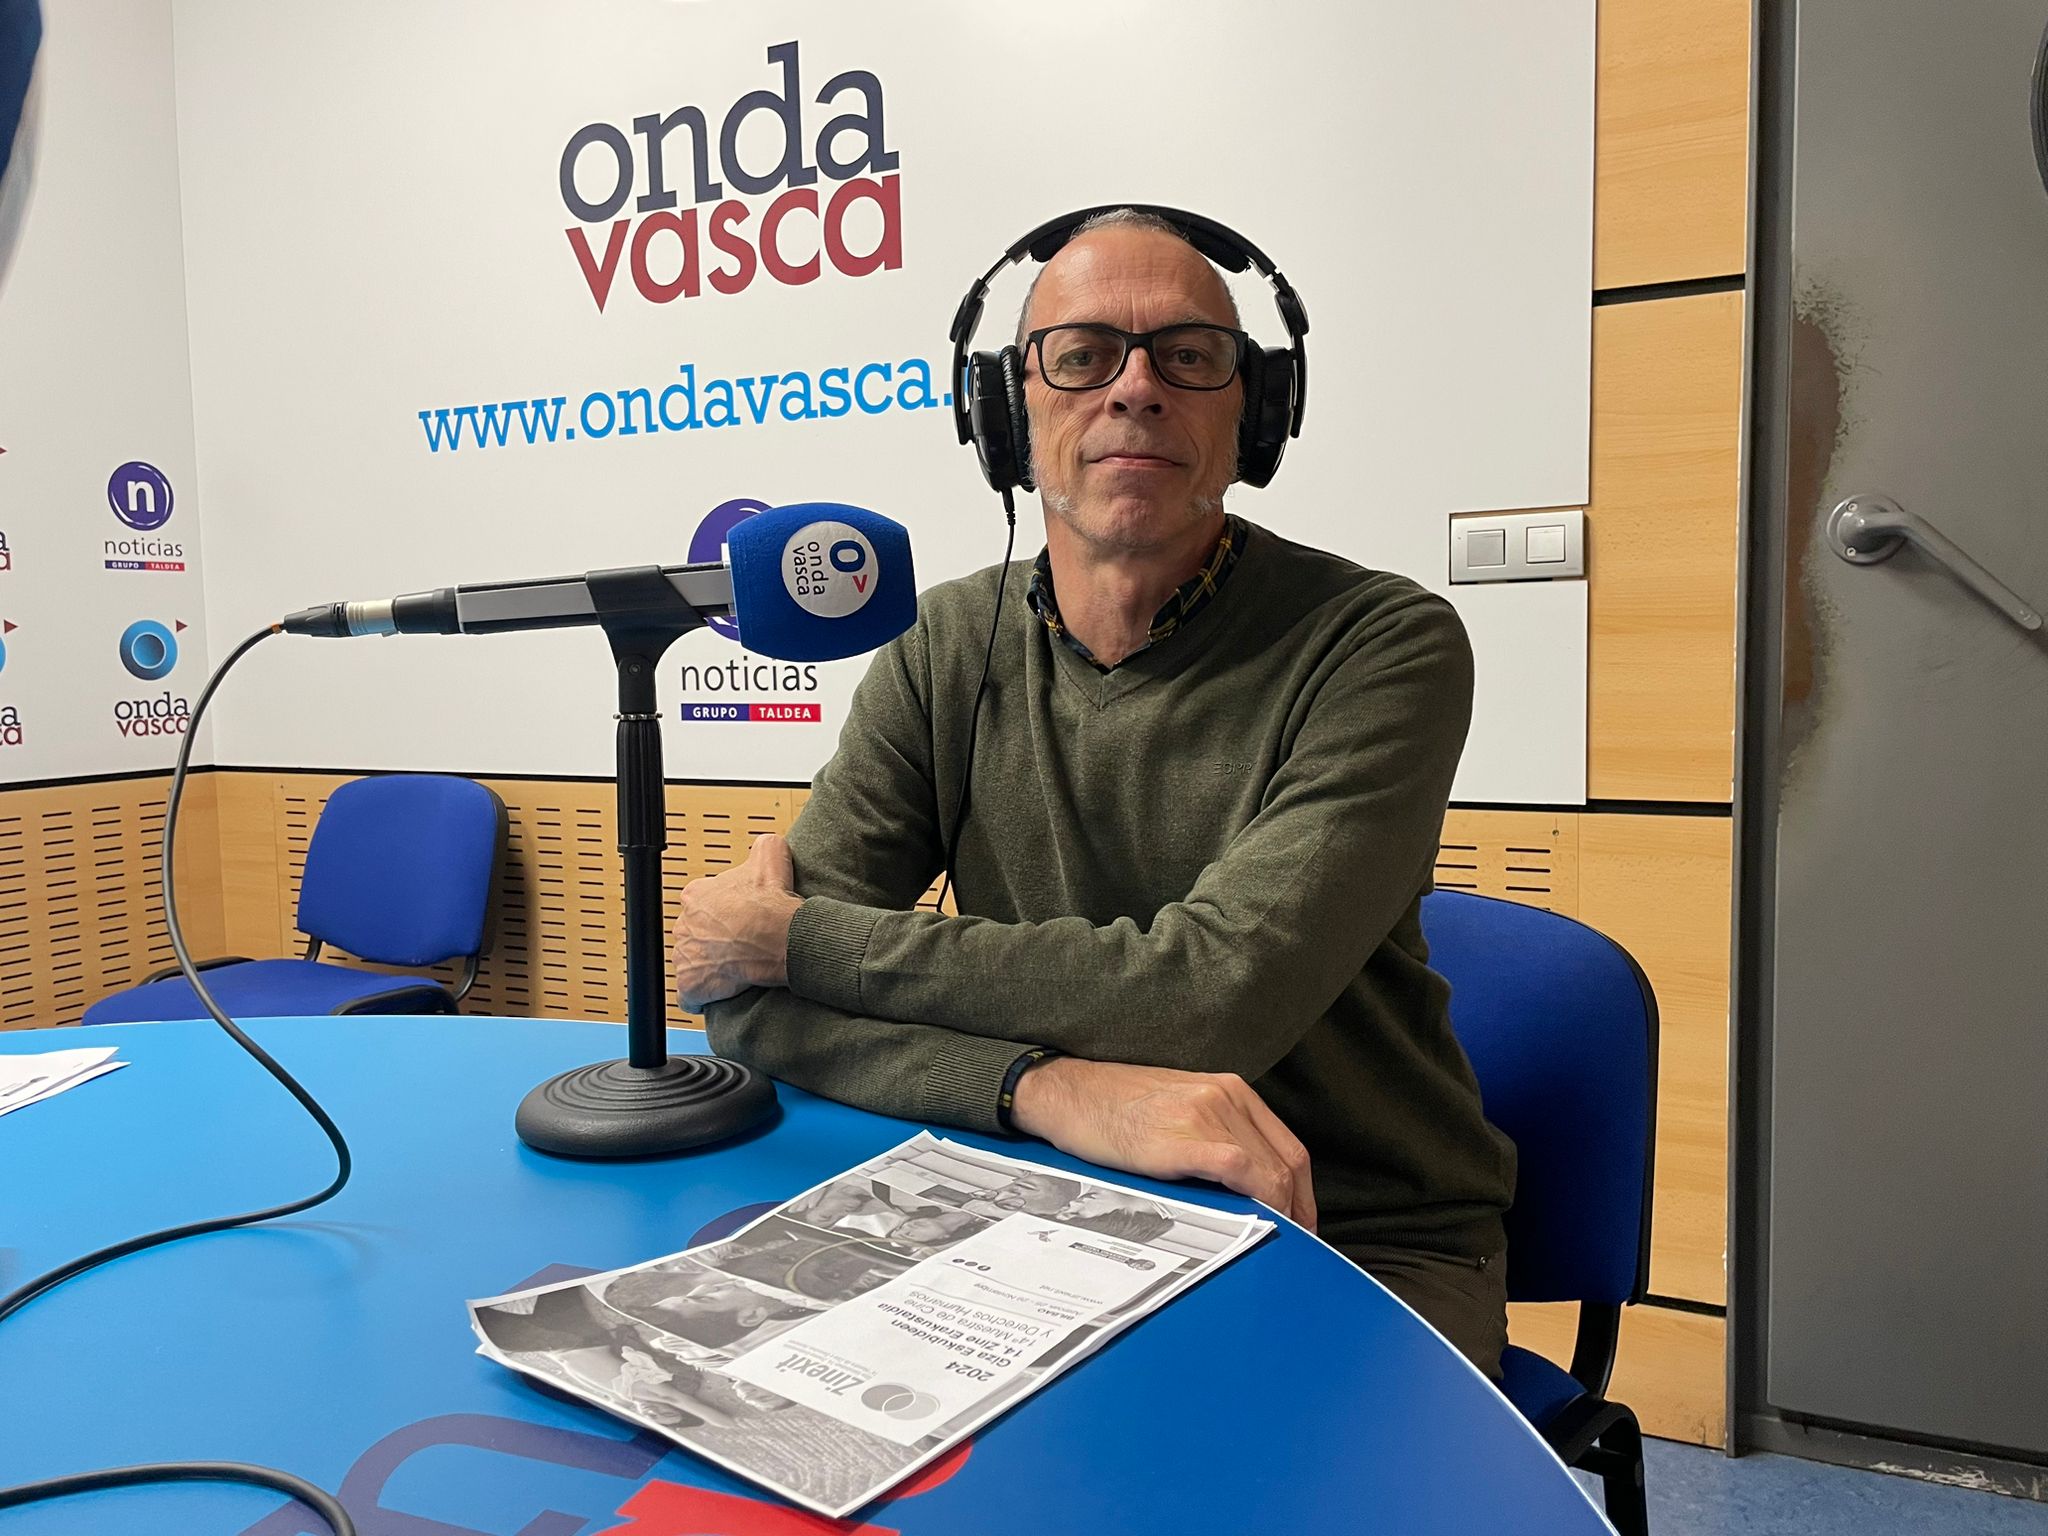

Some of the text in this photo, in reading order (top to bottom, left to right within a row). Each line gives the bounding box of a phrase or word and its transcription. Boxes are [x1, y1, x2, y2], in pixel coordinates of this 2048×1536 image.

[559, 40, 900, 223] onda
[565, 173, 903, 315] vasca
[418, 358, 968, 453] www.ondavasca.
[104, 537, 183, 557] noticias
[111, 561, 181, 571] GRUPO TALDEA
[792, 545, 810, 596] vasca
[807, 541, 829, 595] onda
[681, 656, 818, 692] noticias
[114, 691, 190, 720] onda
[692, 706, 812, 719] GRUPO TALDEA
[904, 1299, 935, 1315] Cine
[909, 1290, 1055, 1339] y Derechos Humanos
[936, 1311, 956, 1322] de
[877, 1302, 1023, 1358] 14. Zine Erakustaldia
[891, 1319, 1011, 1368] Giza Eskubideen
[957, 1318, 1014, 1340] Muestra
[775, 1353, 866, 1396] Zinexit
[944, 1360, 995, 1382] 2024
